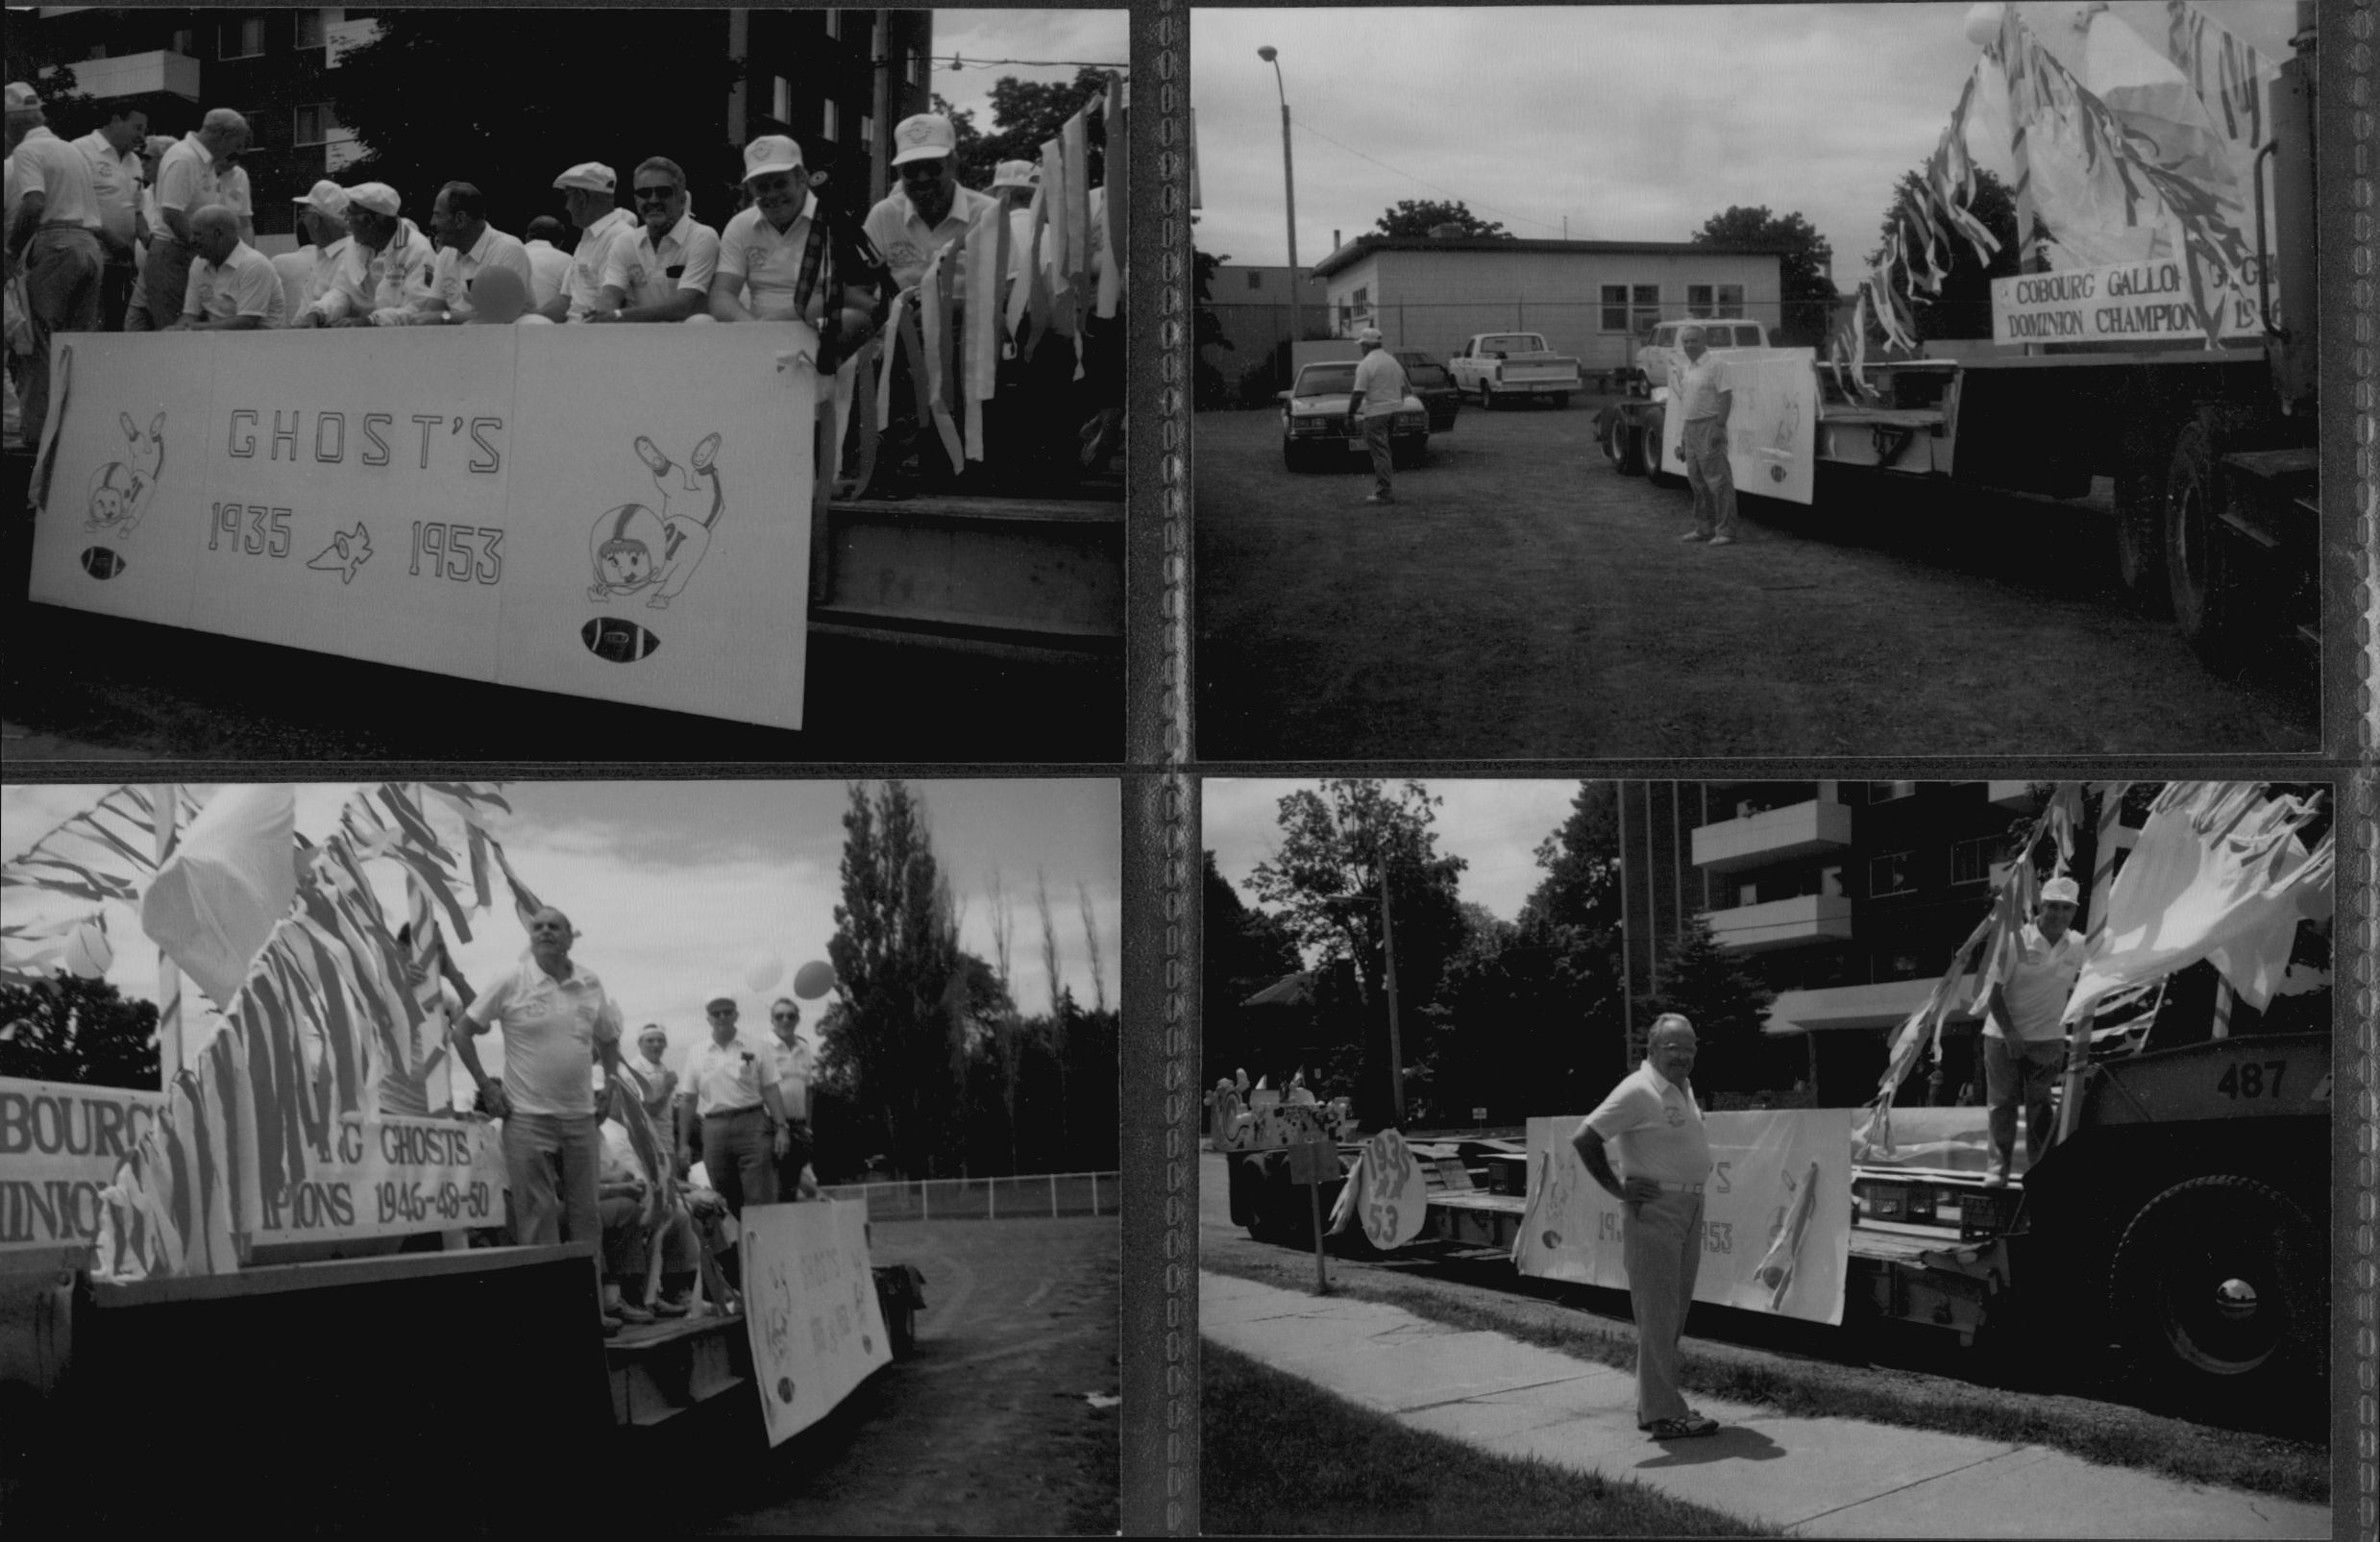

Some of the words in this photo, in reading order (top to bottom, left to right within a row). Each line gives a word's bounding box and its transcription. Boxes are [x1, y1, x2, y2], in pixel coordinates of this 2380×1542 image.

[2017, 273, 2096, 305] COBOURG
[2007, 310, 2084, 338] DOMINION
[229, 409, 503, 474] GHOST'S
[209, 502, 292, 558] 1935
[409, 521, 503, 585] 1953
[2218, 1060, 2287, 1099] 487
[380, 1123, 472, 1165] GHOSTS
[375, 1181, 489, 1224] 1946-48-50
[1699, 1221, 1733, 1255] 953
